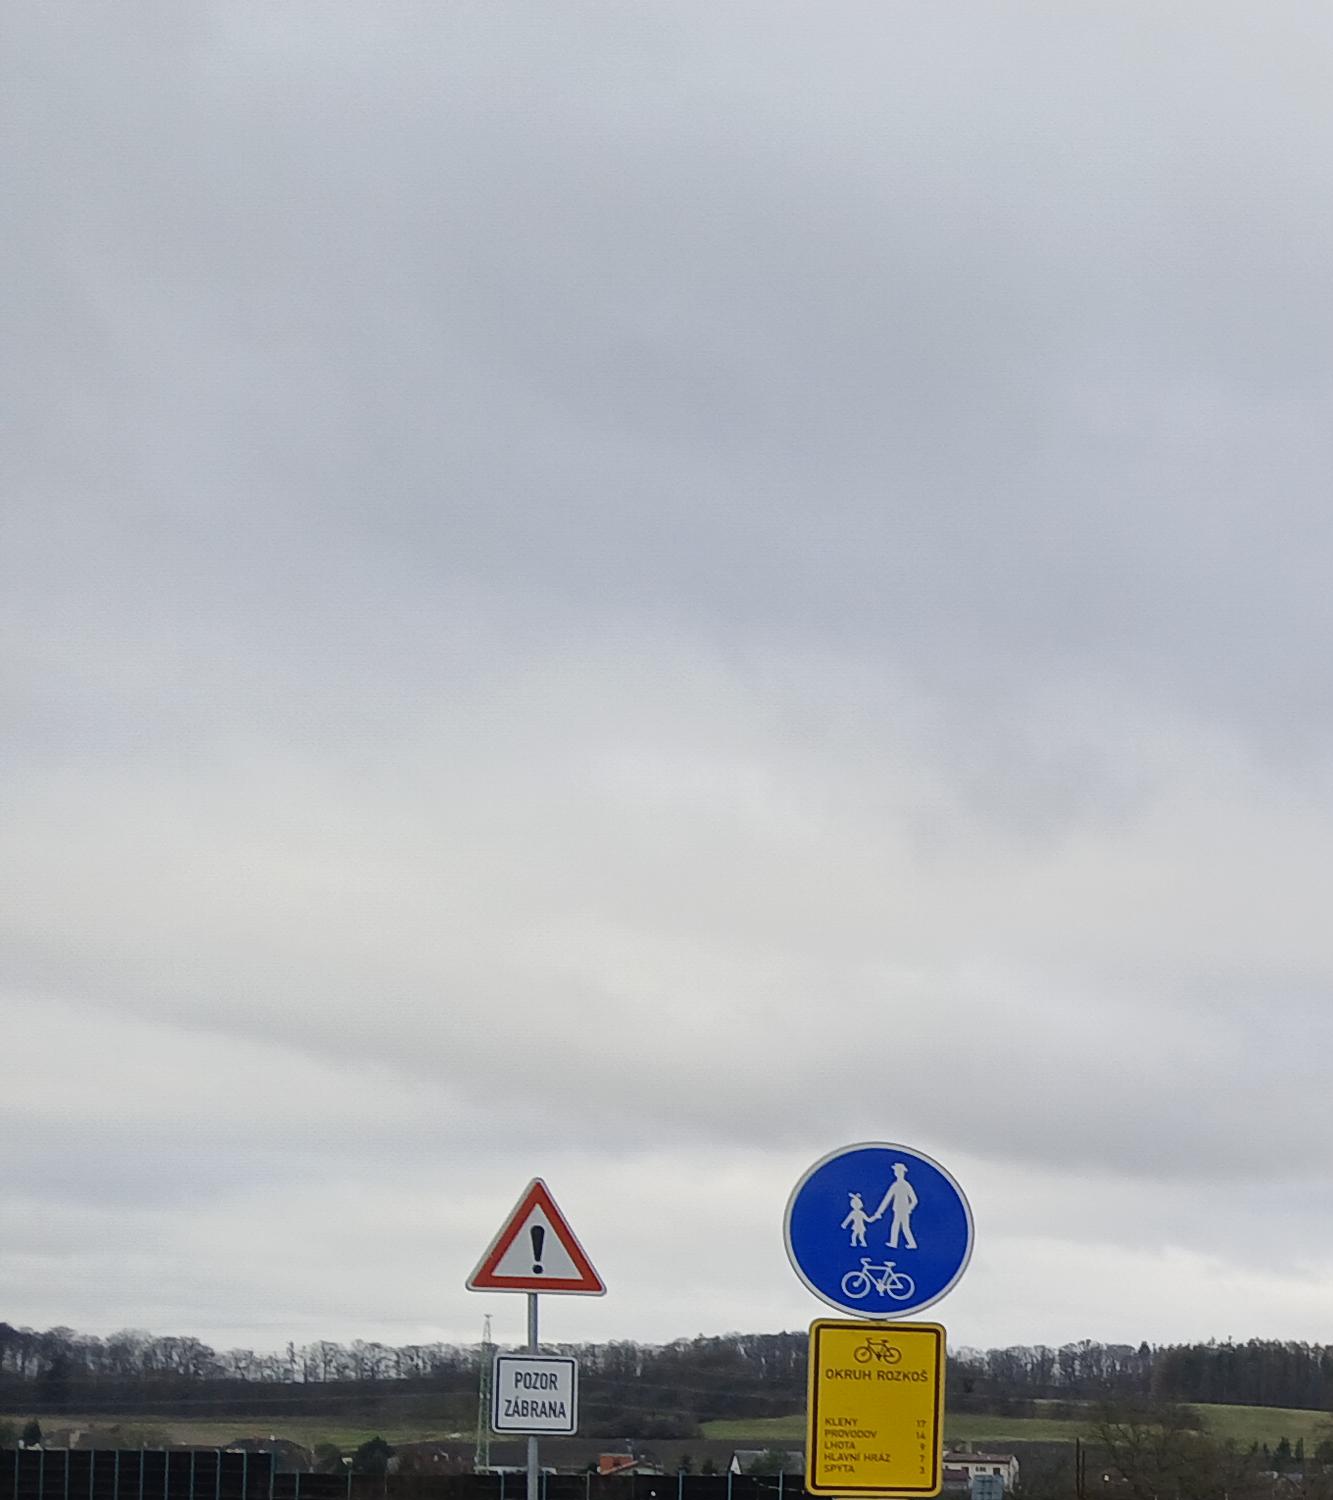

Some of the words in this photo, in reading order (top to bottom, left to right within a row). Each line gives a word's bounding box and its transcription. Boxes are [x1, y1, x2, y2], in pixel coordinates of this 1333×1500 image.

[514, 1371, 559, 1391] POZOR
[825, 1368, 872, 1381] OKRUH
[877, 1369, 929, 1382] ROZKOŠ
[504, 1396, 567, 1419] ZÁBRANA
